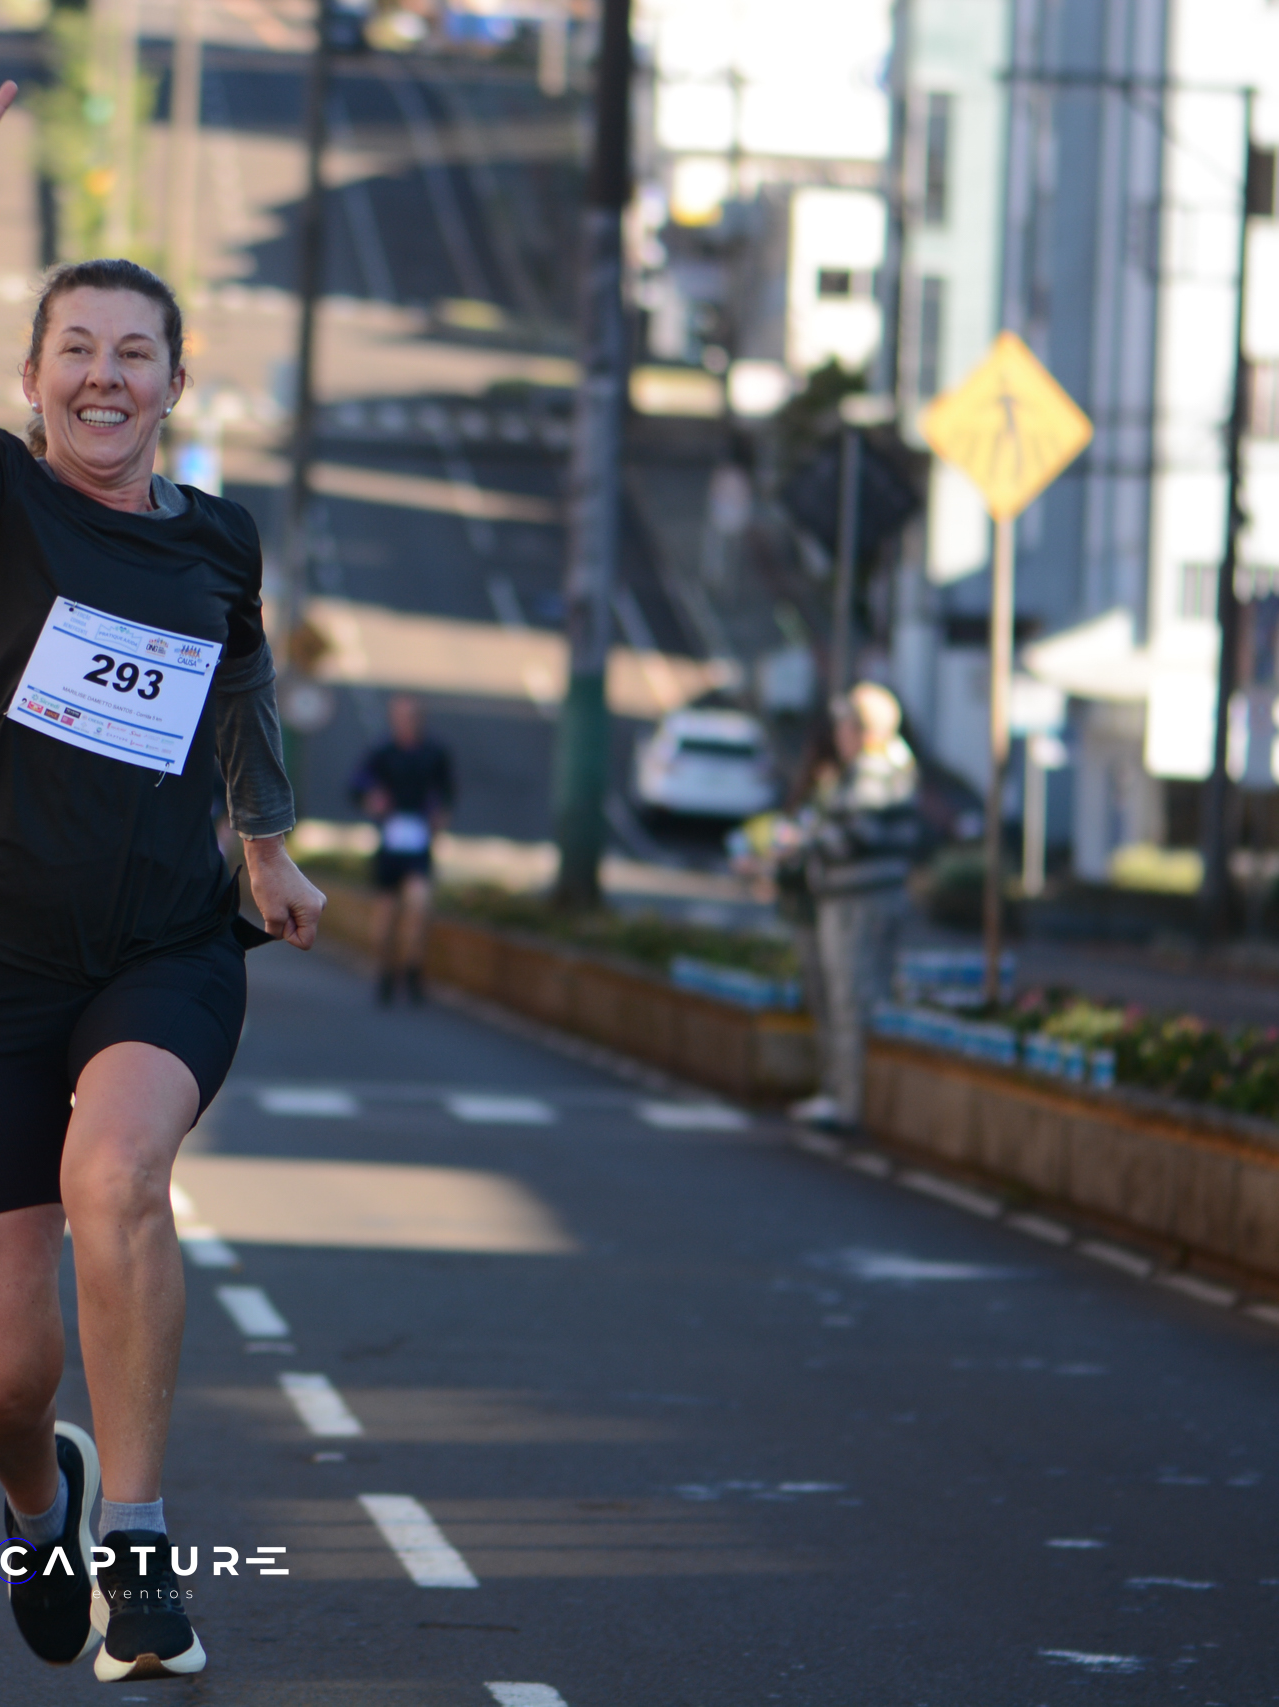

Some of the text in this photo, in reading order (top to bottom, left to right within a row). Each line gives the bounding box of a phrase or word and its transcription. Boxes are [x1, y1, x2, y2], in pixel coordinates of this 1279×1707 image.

[177, 656, 197, 668] CAUSA
[83, 653, 164, 701] 293
[112, 704, 133, 715] SANTOS
[136, 711, 152, 720] Corrida
